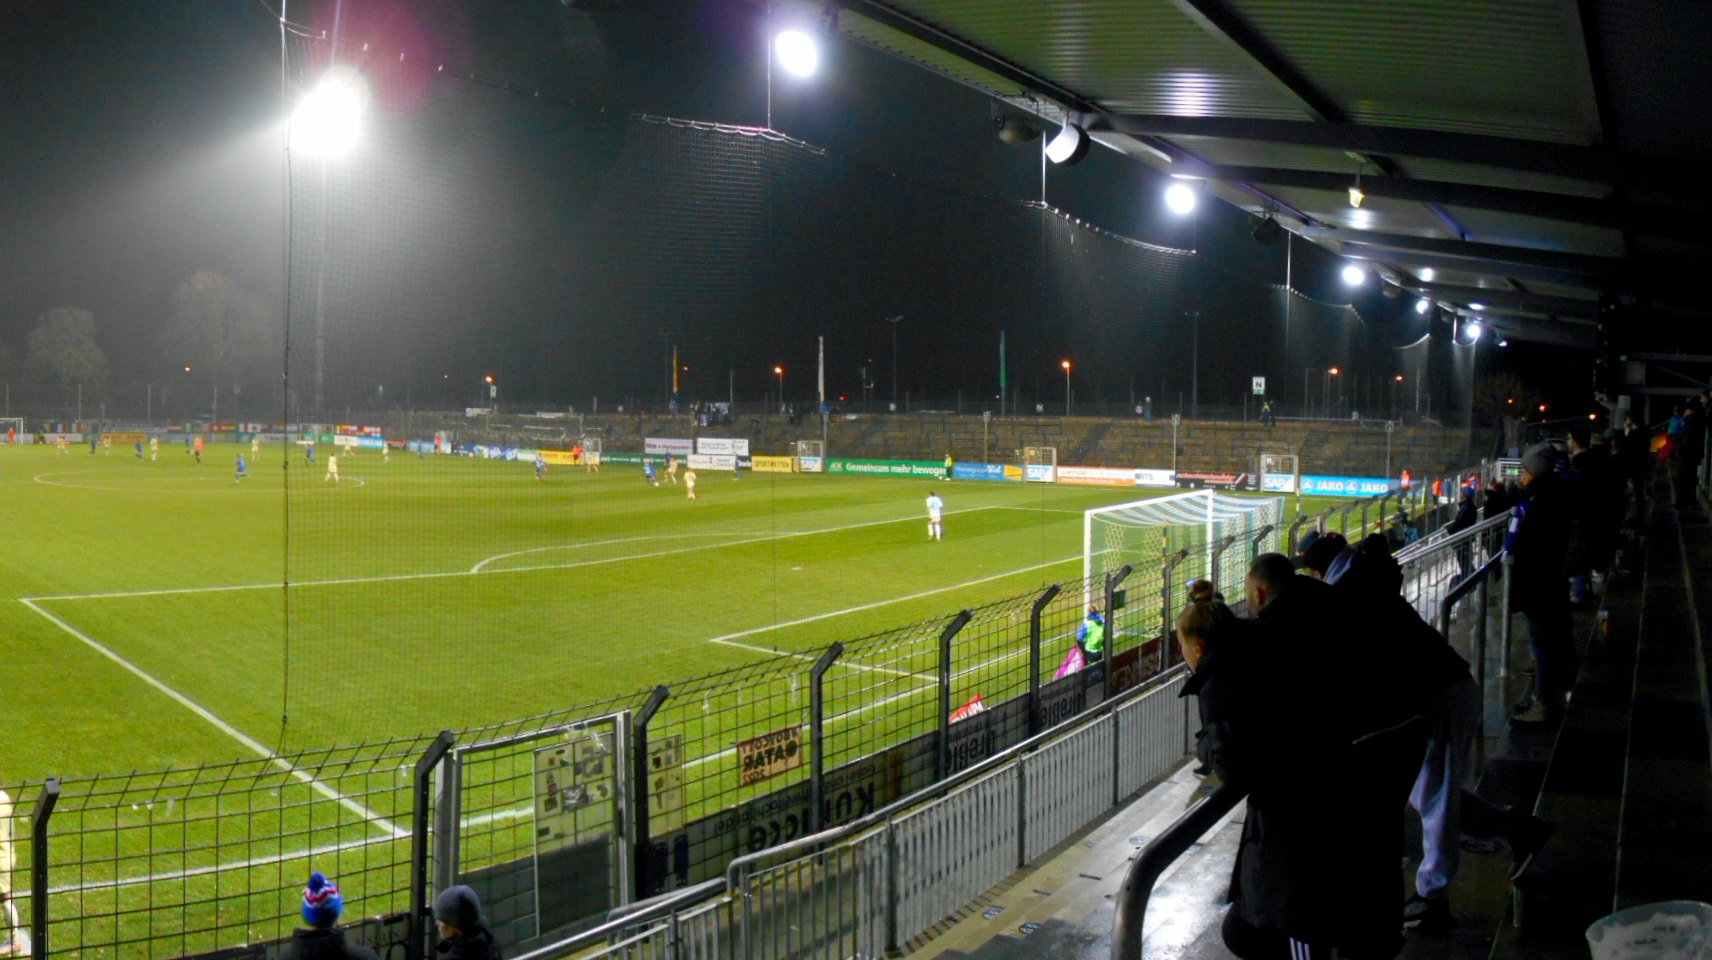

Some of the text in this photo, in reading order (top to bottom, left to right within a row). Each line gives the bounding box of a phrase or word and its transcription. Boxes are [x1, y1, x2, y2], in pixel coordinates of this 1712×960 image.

[754, 460, 790, 469] SPORTWETTEN
[846, 462, 889, 473] Gemeinsam
[890, 464, 912, 474] mehr
[1264, 476, 1286, 490] SAP
[1315, 480, 1389, 494] JAKO JAKO
